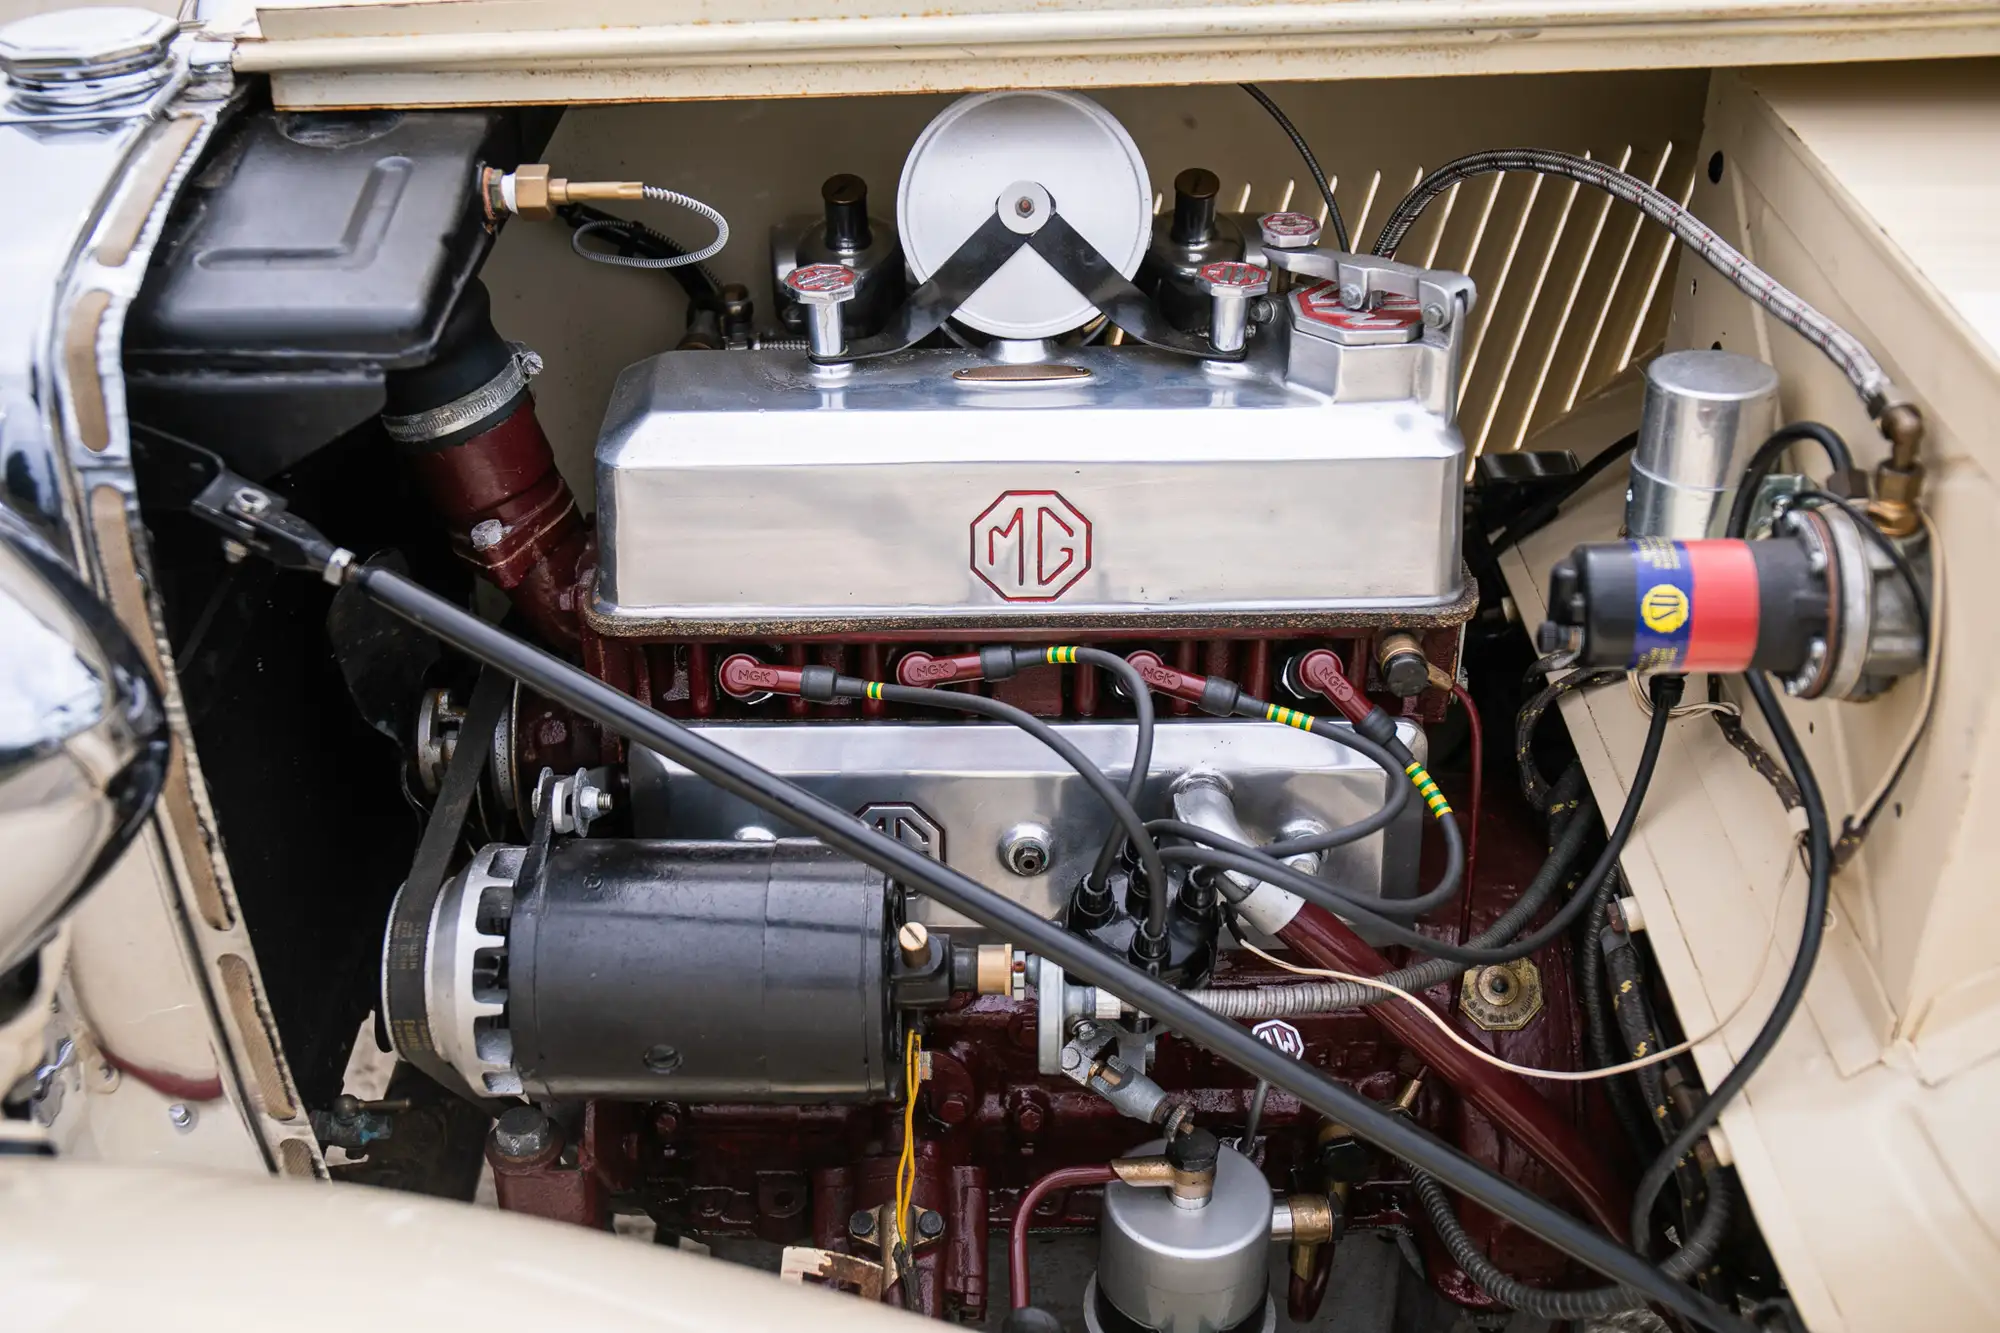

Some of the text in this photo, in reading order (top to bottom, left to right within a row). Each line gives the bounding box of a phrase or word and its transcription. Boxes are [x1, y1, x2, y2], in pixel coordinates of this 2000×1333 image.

[988, 507, 1074, 587] MG
[737, 668, 772, 685] NGK
[916, 661, 950, 680] NGK
[1141, 666, 1176, 687] NGK
[1319, 666, 1349, 696] NGK
